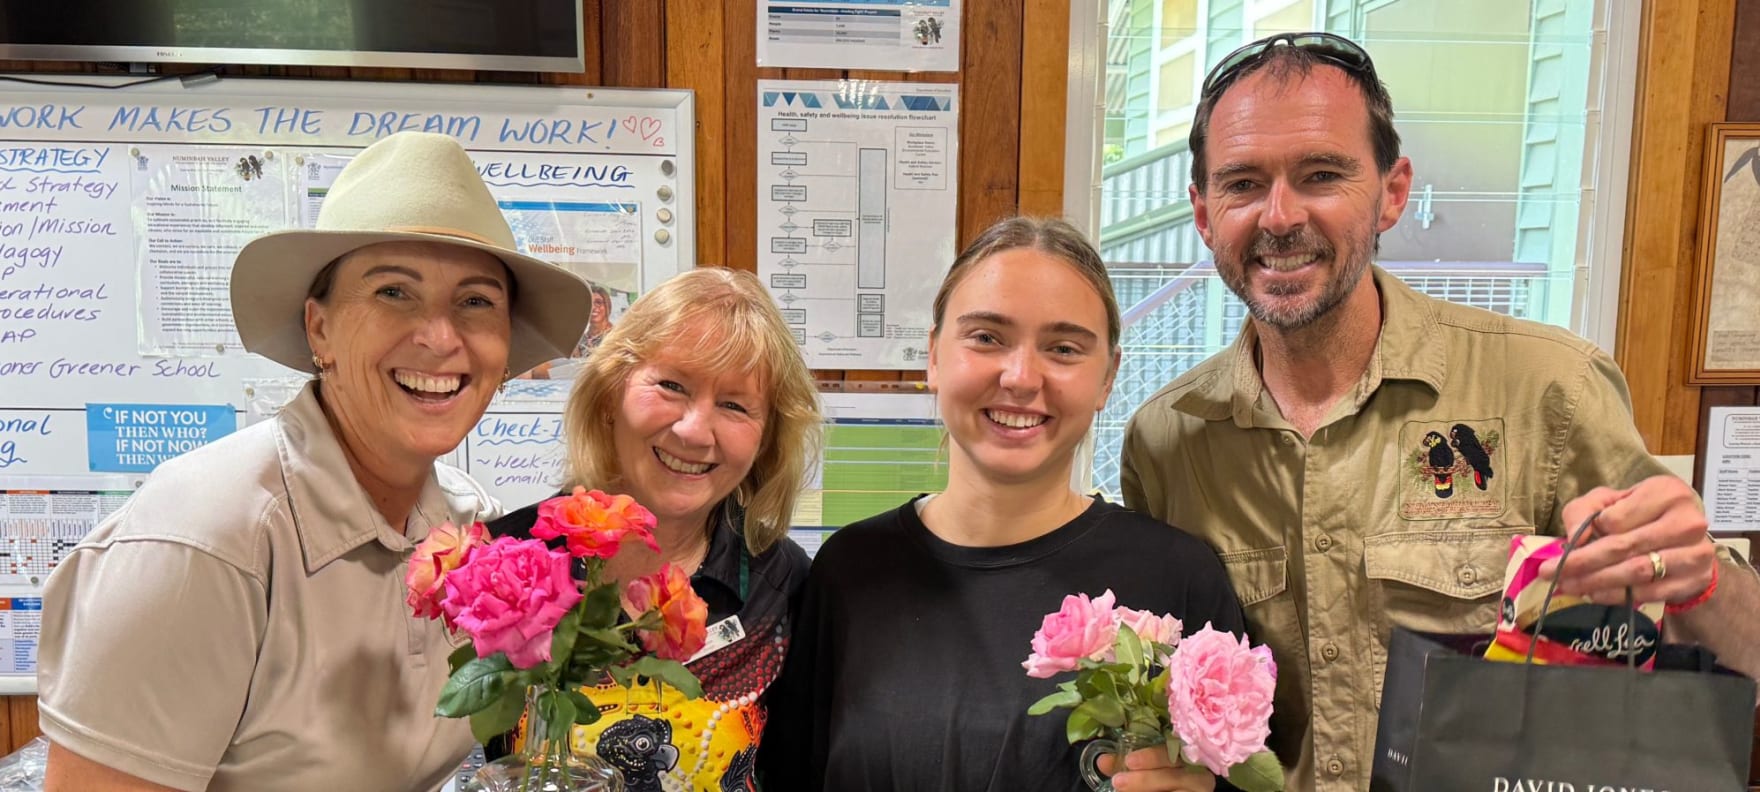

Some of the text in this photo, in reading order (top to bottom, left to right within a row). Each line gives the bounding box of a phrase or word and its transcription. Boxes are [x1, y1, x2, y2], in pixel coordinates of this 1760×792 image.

[832, 112, 859, 120] wellbeing
[108, 105, 232, 132] MAKES
[254, 106, 324, 134] THE
[347, 111, 480, 141] DREAM
[499, 117, 617, 150] WORK!
[0, 147, 110, 168] STRATEGY
[472, 161, 633, 182] WELLBEING
[26, 176, 118, 199] Strategy
[171, 184, 242, 192] Mission Statement
[0, 196, 57, 214] ment
[528, 244, 576, 256] Wellbeing
[49, 358, 141, 378] Greener
[152, 359, 221, 378] School
[115, 410, 207, 425] IF NOT YOU
[114, 426, 207, 438] THEN WHO?
[477, 416, 565, 437] Check-I
[116, 440, 129, 452] IF
[132, 440, 166, 453] NOT
[116, 453, 158, 466] THEN
[495, 472, 549, 486] emails
[1493, 776, 1575, 792] DAVID
